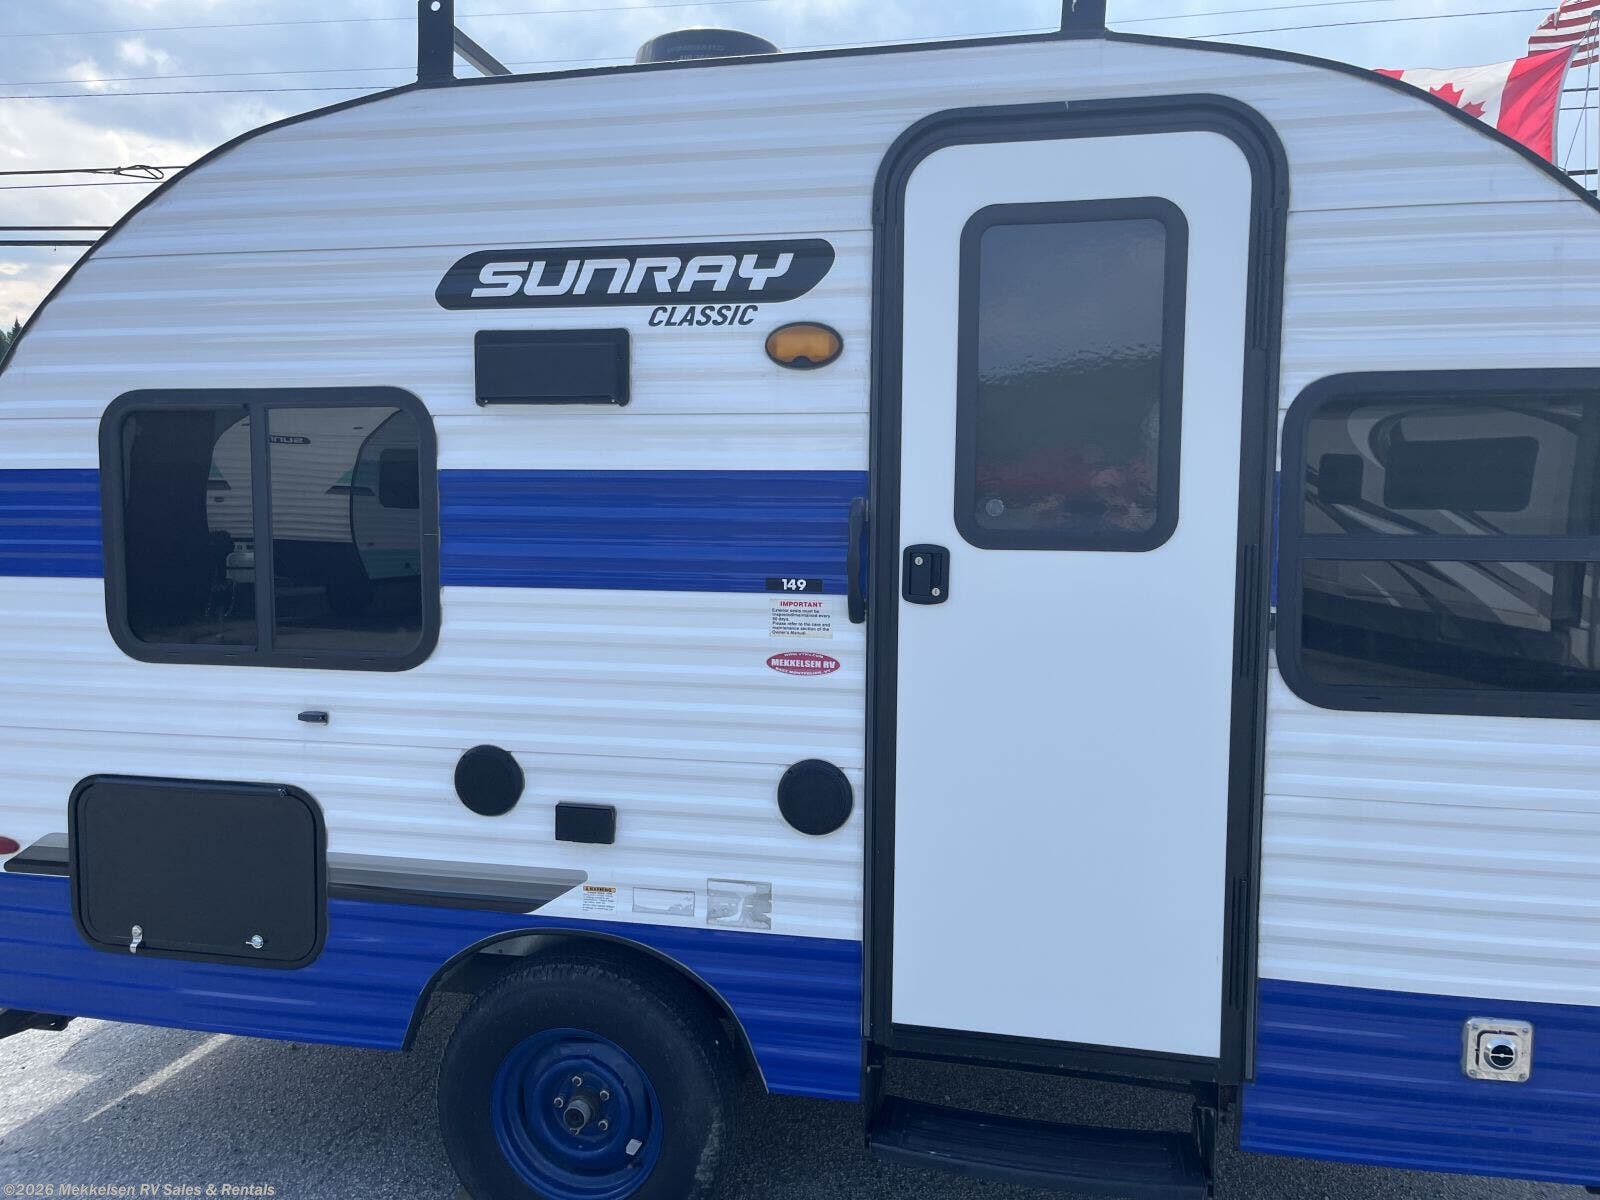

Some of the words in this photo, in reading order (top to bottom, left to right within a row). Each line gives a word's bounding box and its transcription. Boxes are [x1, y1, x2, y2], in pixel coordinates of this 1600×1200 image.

[470, 253, 794, 298] SUNRAY
[648, 304, 758, 328] CLASSIC
[782, 578, 807, 591] 149
[771, 659, 821, 668] MEKKELSEN
[823, 661, 836, 669] RV
